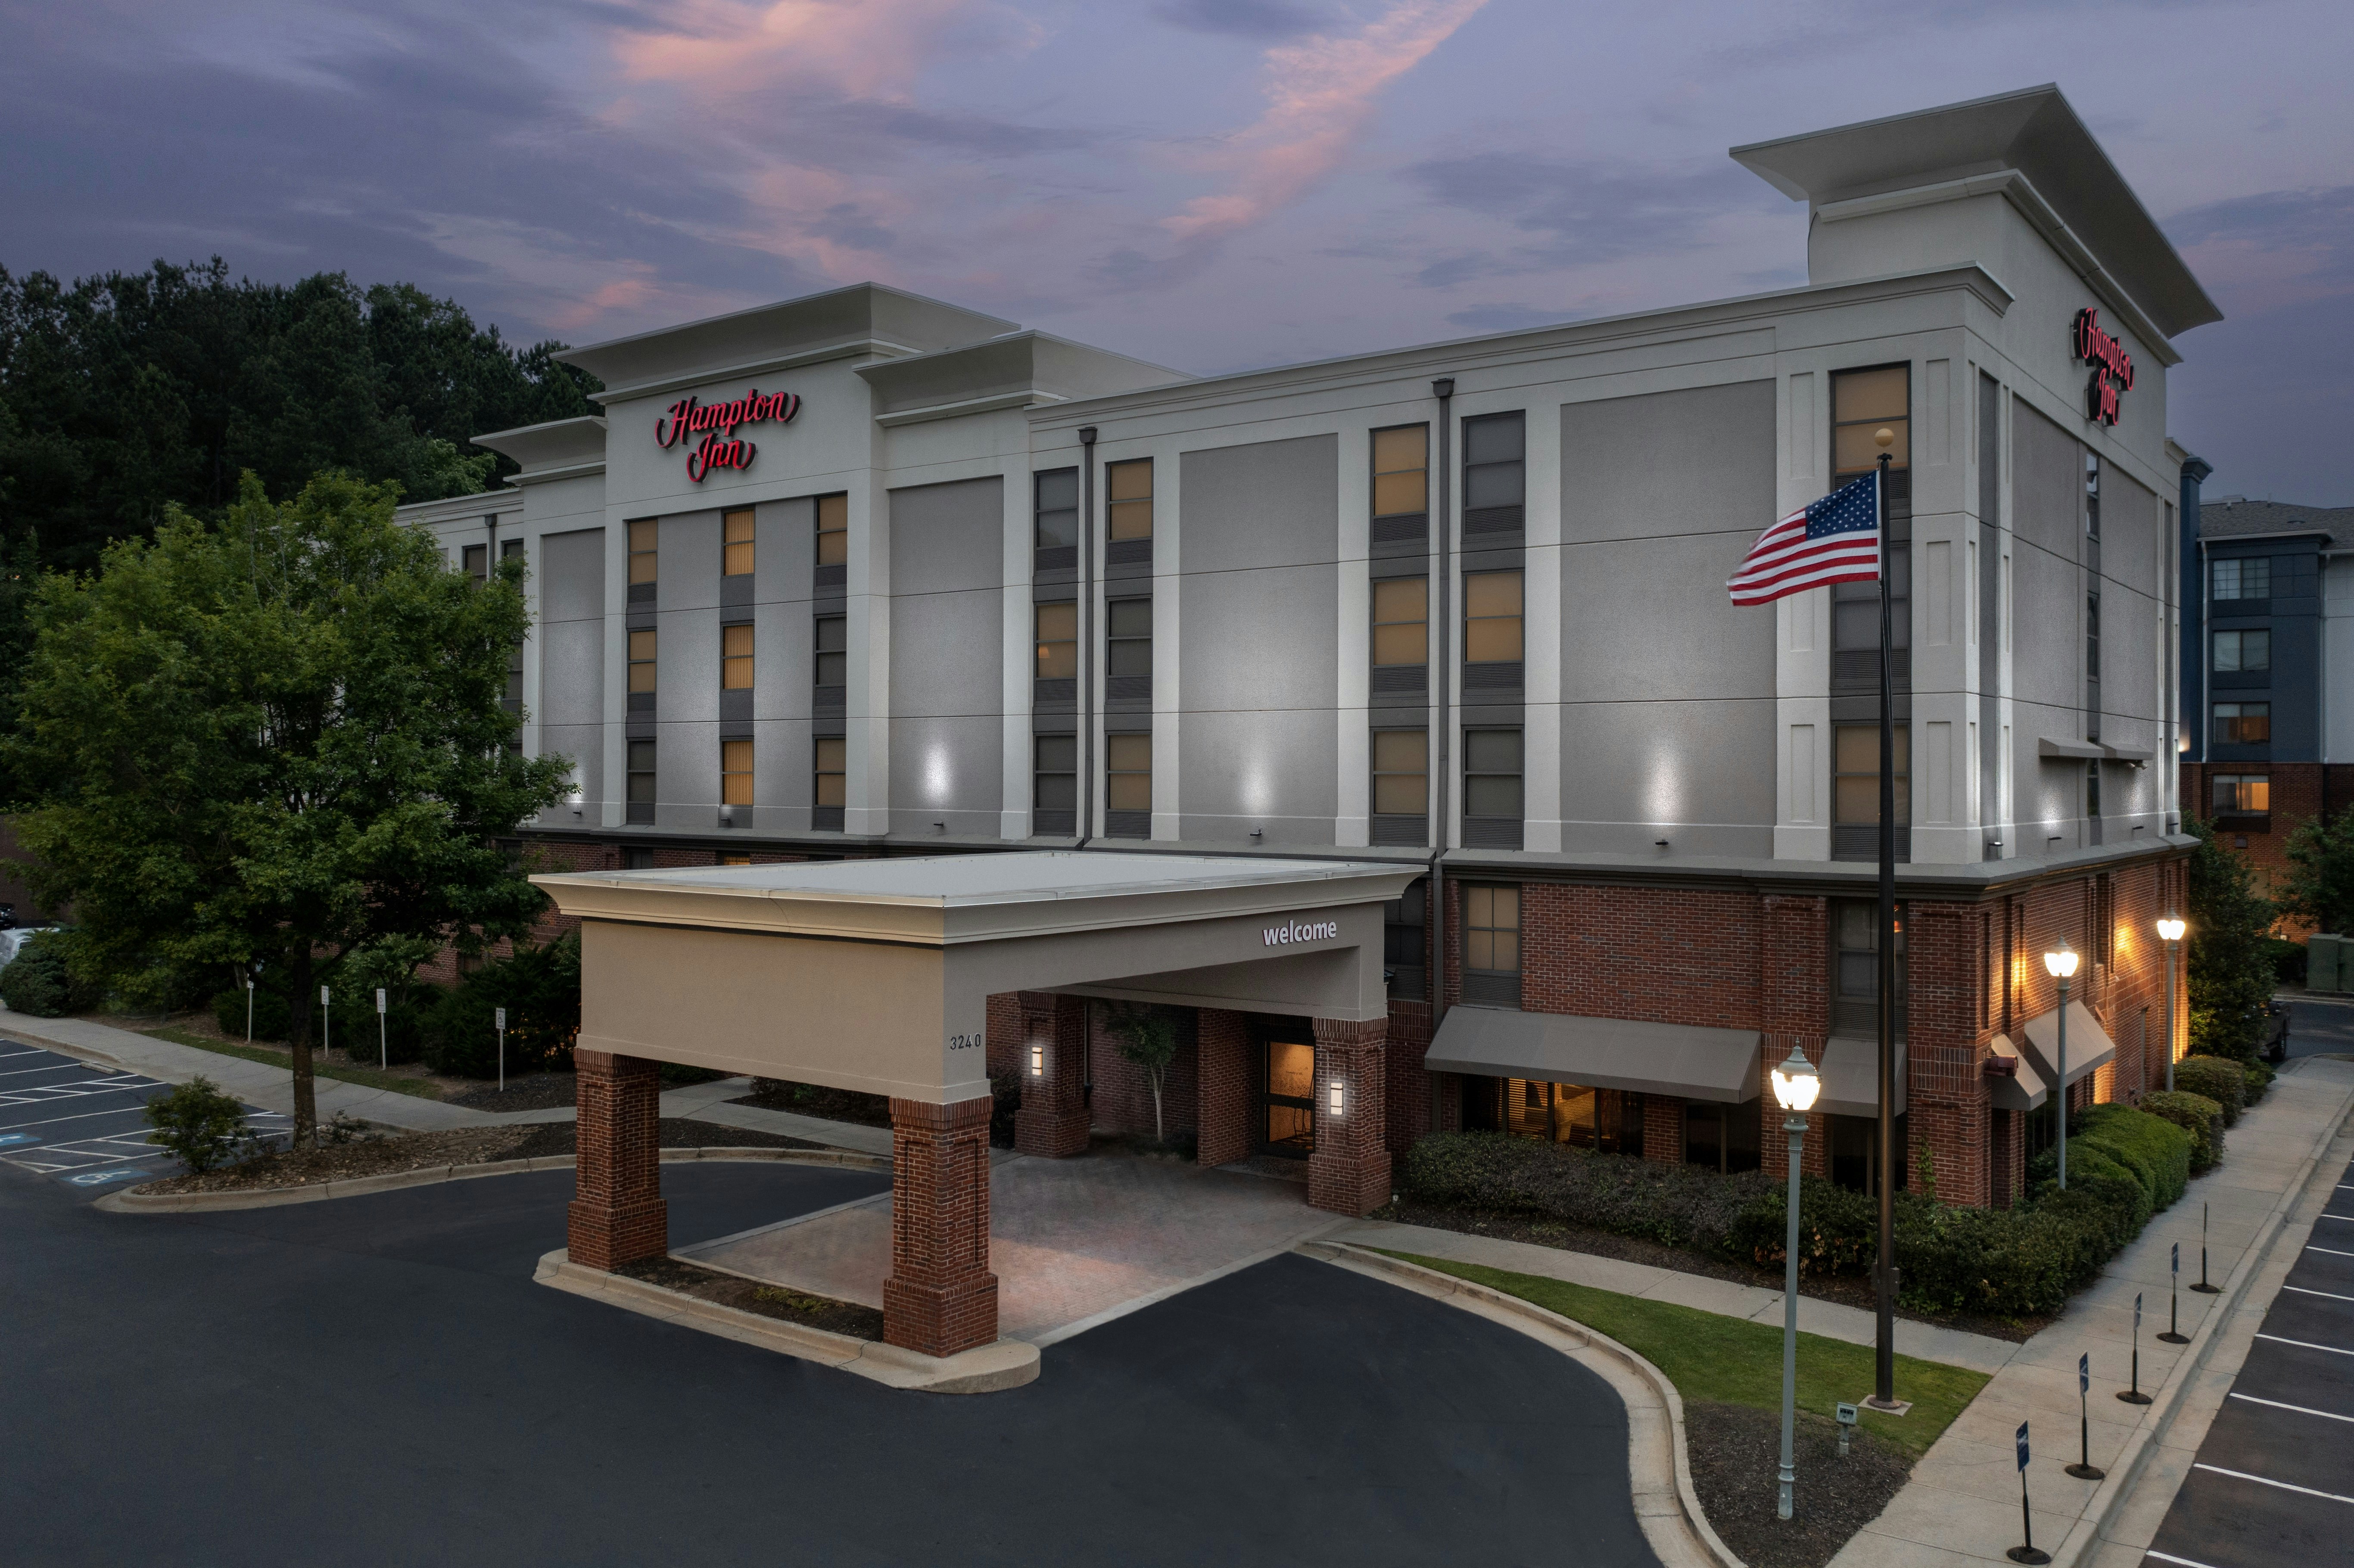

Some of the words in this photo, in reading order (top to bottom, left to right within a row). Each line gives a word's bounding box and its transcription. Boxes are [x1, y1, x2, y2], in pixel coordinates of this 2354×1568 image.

[2080, 307, 2134, 391] Hampton
[655, 389, 800, 448] Hampton
[2096, 367, 2120, 426] Inn
[687, 432, 756, 482] Inn
[1263, 920, 1337, 946] welcome
[950, 1033, 981, 1050] 3240
